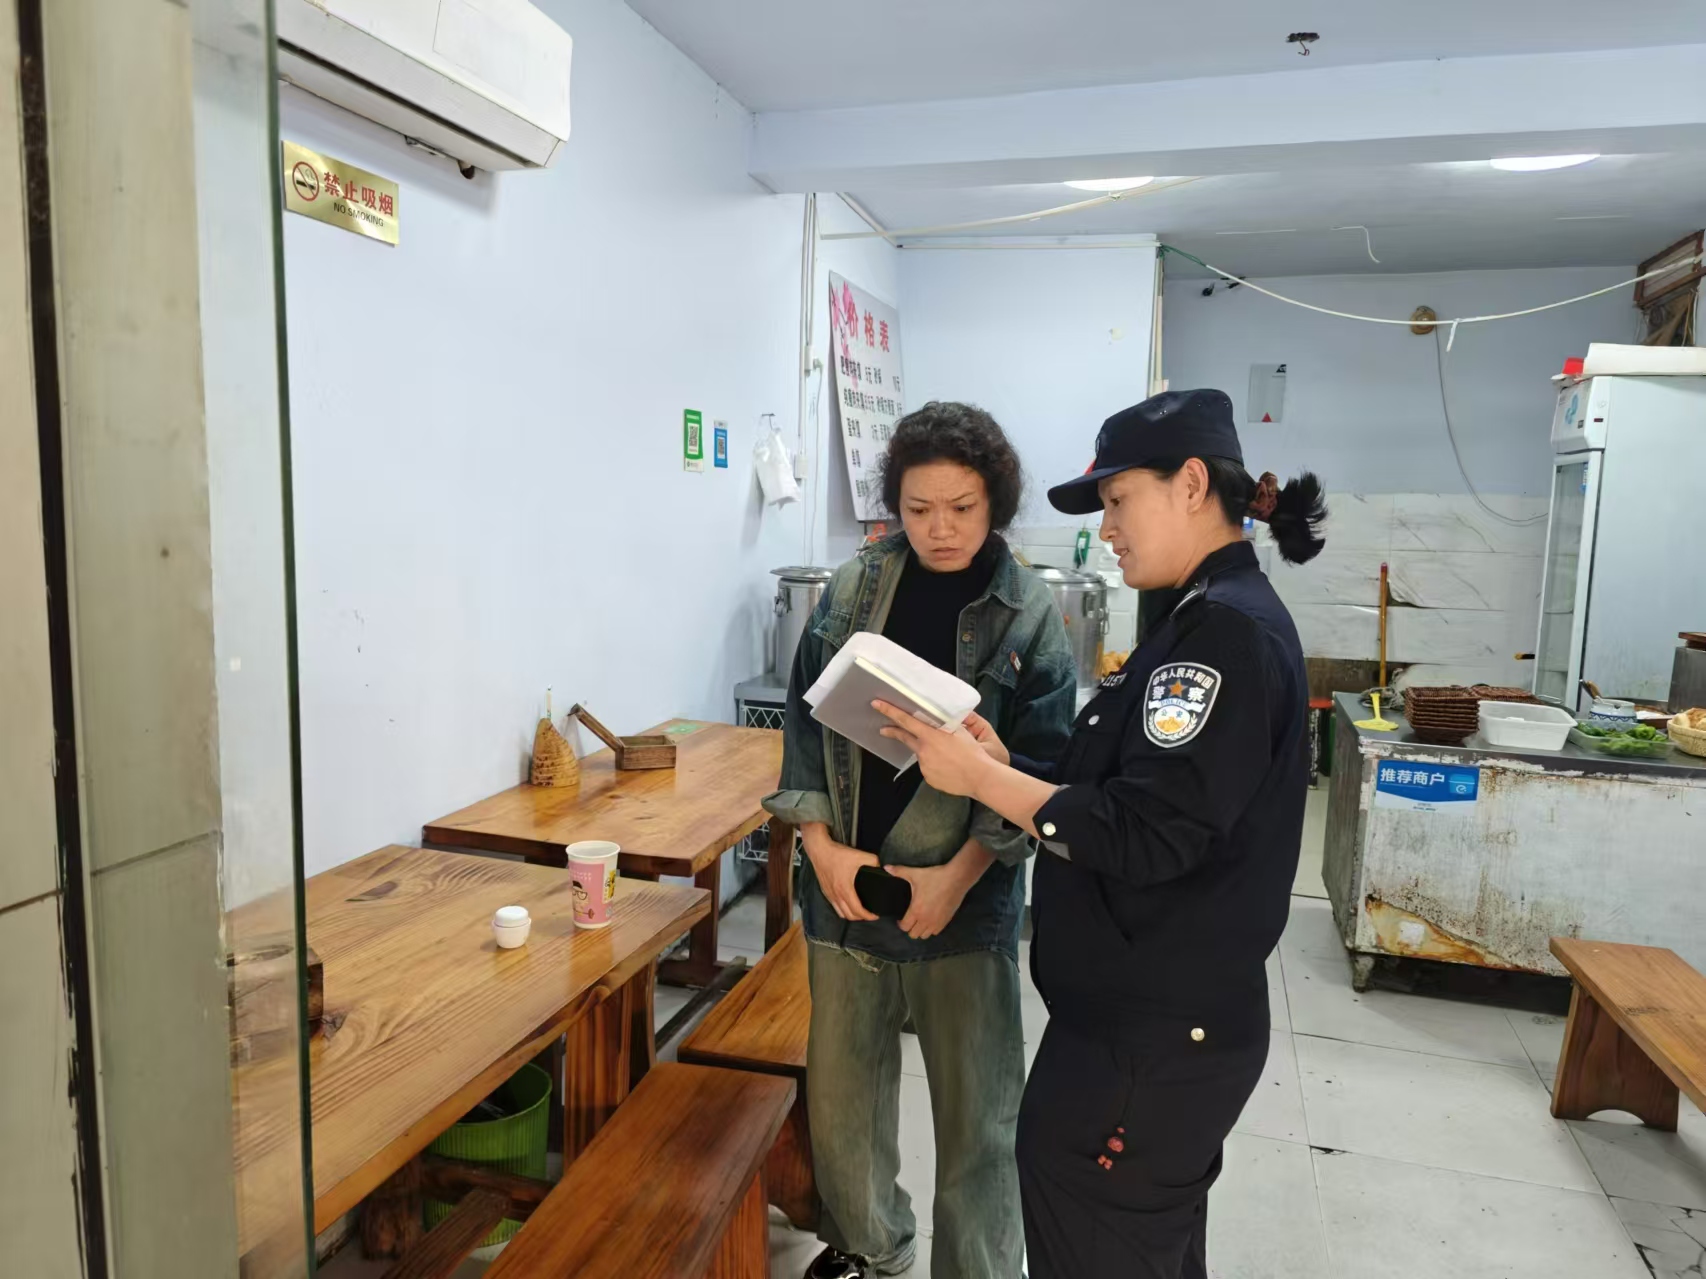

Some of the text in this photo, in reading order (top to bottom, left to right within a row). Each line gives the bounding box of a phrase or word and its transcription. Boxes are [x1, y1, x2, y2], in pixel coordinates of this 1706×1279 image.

[323, 171, 393, 217] 禁止吸烟
[333, 202, 384, 228] NO SMOKING
[847, 301, 891, 353] 价格表
[1152, 667, 1216, 690] 中华人民共和国
[1380, 767, 1446, 787] 推荐商户
